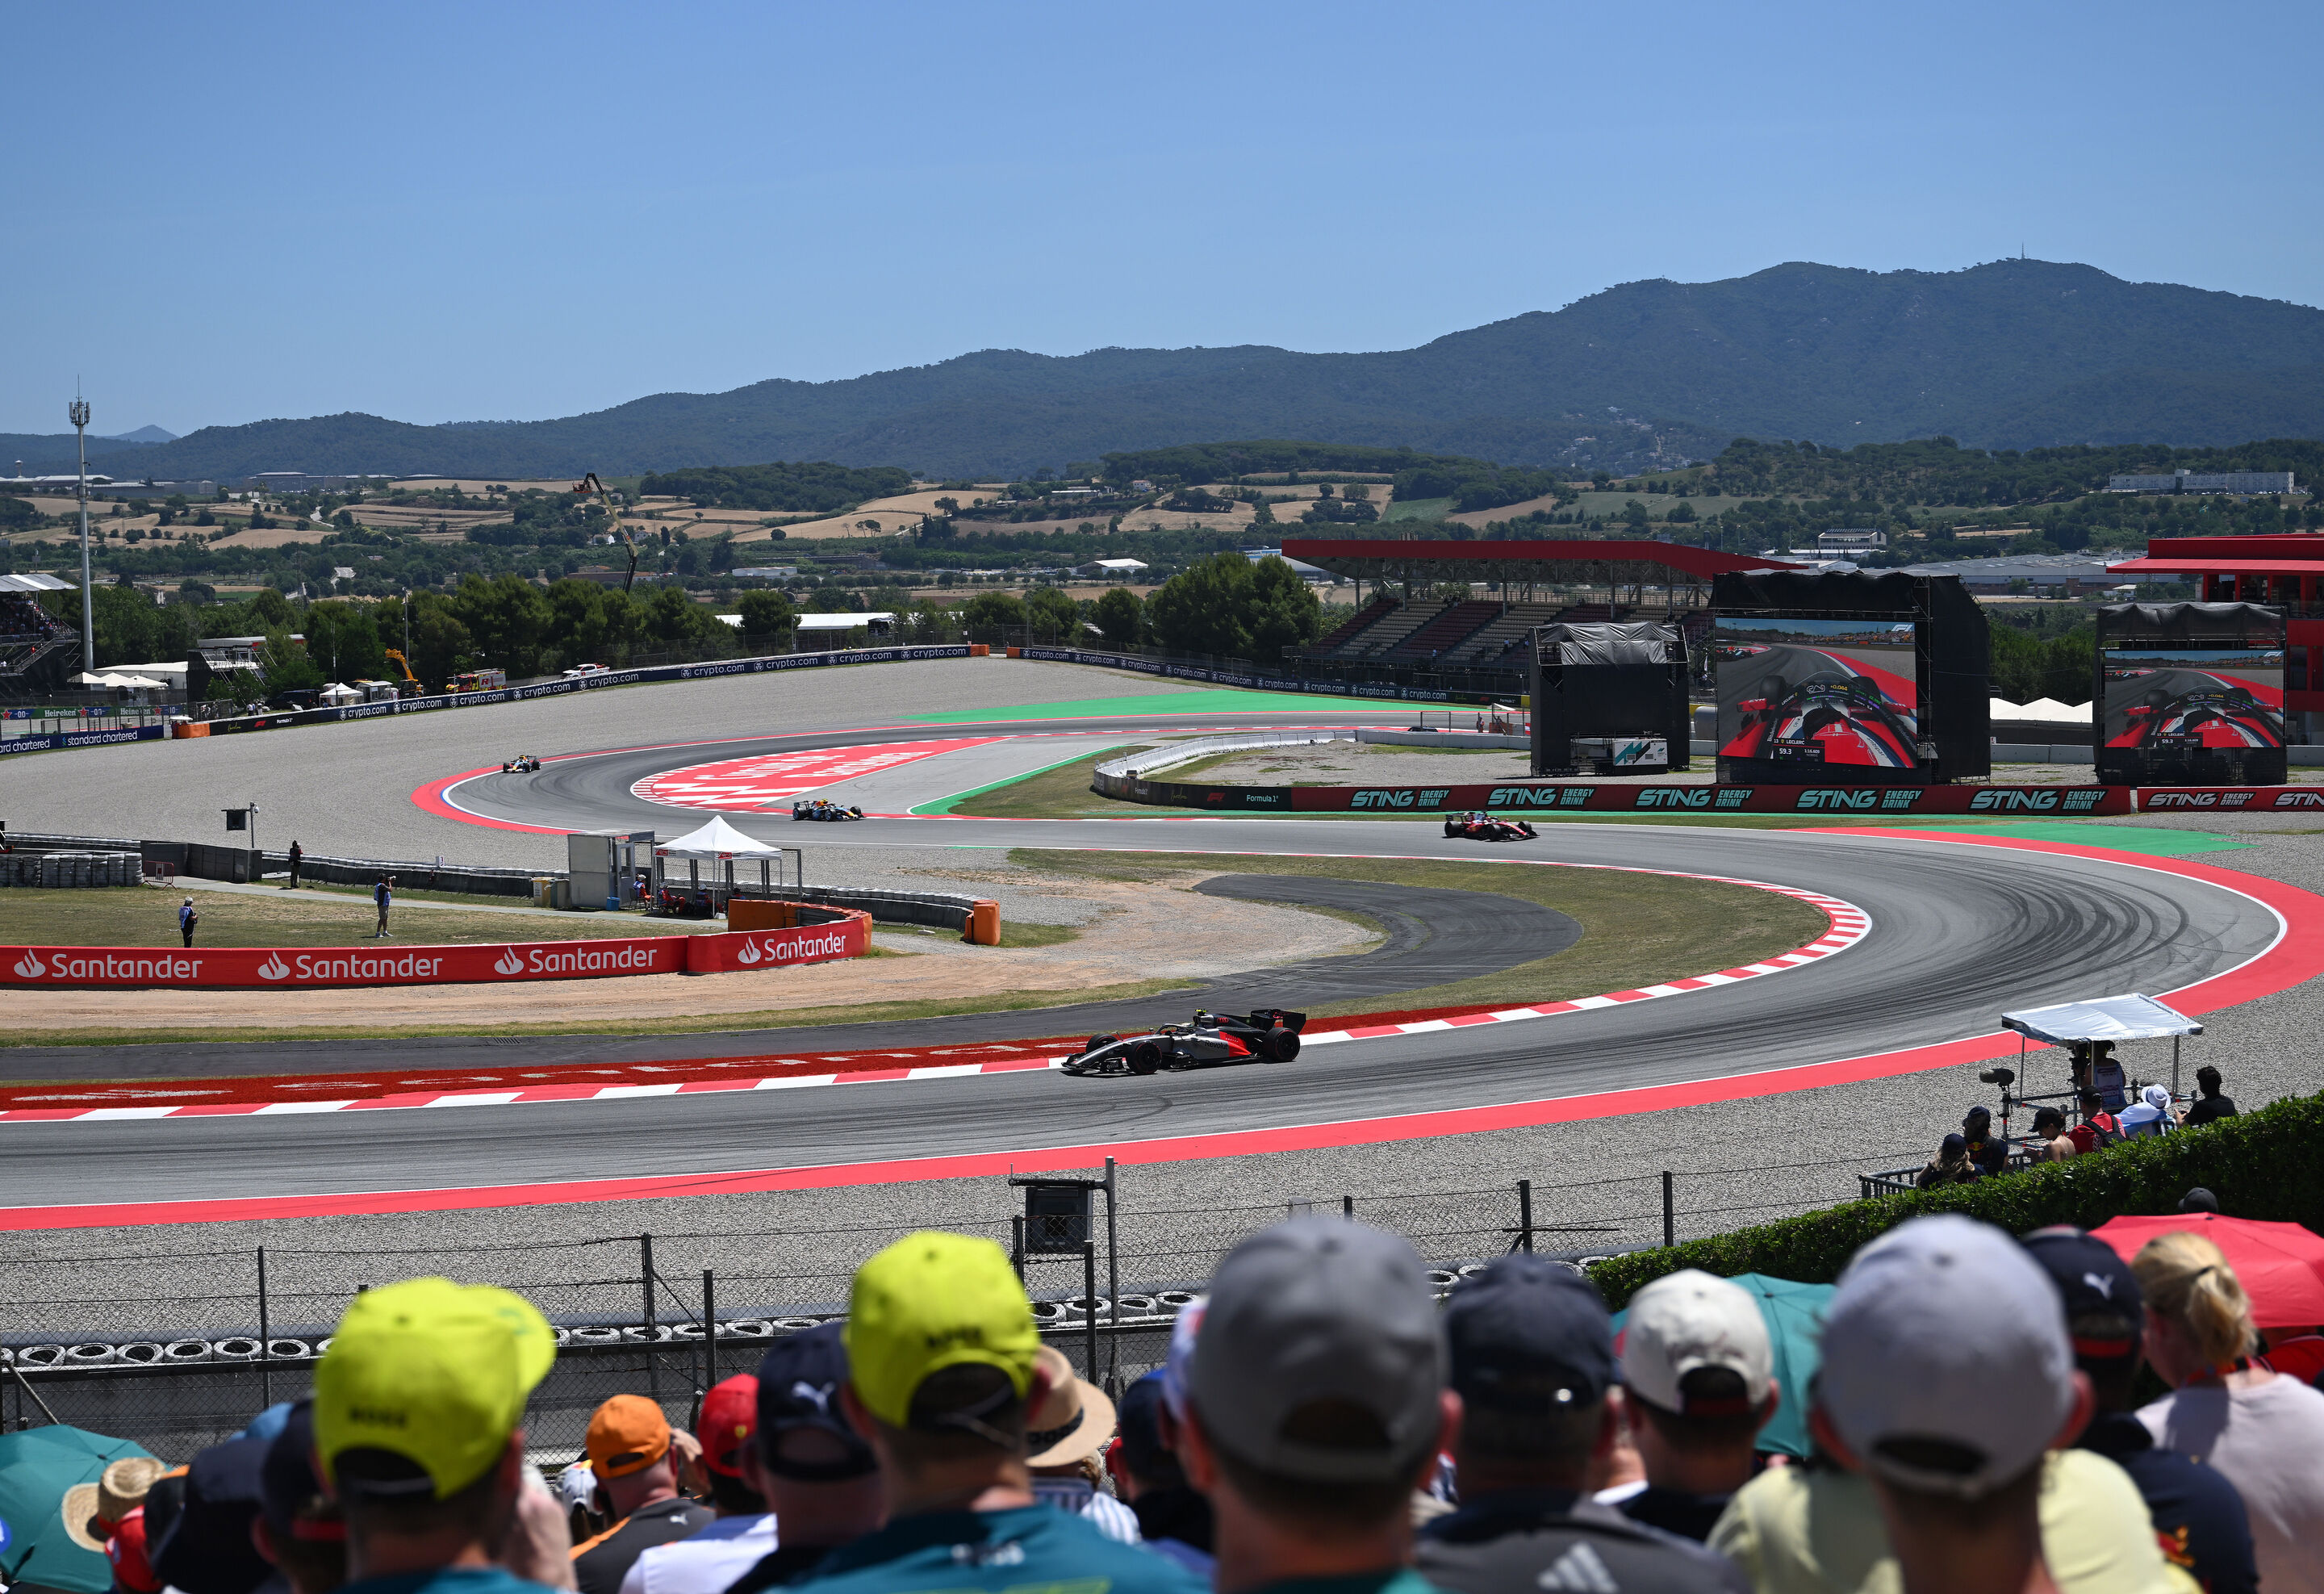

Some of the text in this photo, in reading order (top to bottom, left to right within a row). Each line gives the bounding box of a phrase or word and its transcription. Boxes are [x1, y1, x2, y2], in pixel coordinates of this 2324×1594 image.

[839, 651, 892, 664] crypto.com
[913, 647, 966, 660] crypto.com
[1031, 651, 1068, 659] crypto.com
[1083, 655, 1115, 664] crypto.com
[767, 658, 818, 669] crypto.com
[1128, 659, 1160, 671] crypto.com
[694, 664, 745, 676] crypto.com
[1173, 666, 1206, 678] crypto.com
[589, 673, 639, 687] crypto.com
[1219, 673, 1252, 685] crypto.com
[1264, 680, 1298, 689] crypto.com
[525, 684, 571, 697] crypto.com
[1311, 684, 1345, 692] crypto.com
[1359, 687, 1394, 697] crypto.com
[460, 693, 504, 705] crypto.com
[1409, 690, 1447, 700] crypto.com
[402, 700, 441, 711] crypto.com
[348, 706, 387, 718] crypto.com
[68, 730, 137, 746] standard chartered
[12, 738, 50, 751] chartered
[1246, 794, 1272, 802] Formula
[1351, 790, 1449, 806] STING ENERGY
[1418, 798, 1440, 806] DRINK
[1488, 789, 1595, 805] STING ENERGY
[1560, 797, 1585, 805] DRINK
[1636, 789, 1752, 806] STING ENERGY
[1715, 798, 1742, 807] DRINK
[1797, 790, 1922, 808] STING ENERGY
[1971, 791, 2105, 809] STING ENERGY
[2148, 793, 2217, 805] STING
[1882, 799, 1910, 808] DRINK
[2063, 801, 2093, 810] DRINK
[764, 932, 846, 962] Santander
[529, 945, 657, 973] Santander
[52, 954, 203, 978] Santander
[296, 953, 443, 979] Santander
[1205, 1040, 1228, 1050] Revolut
